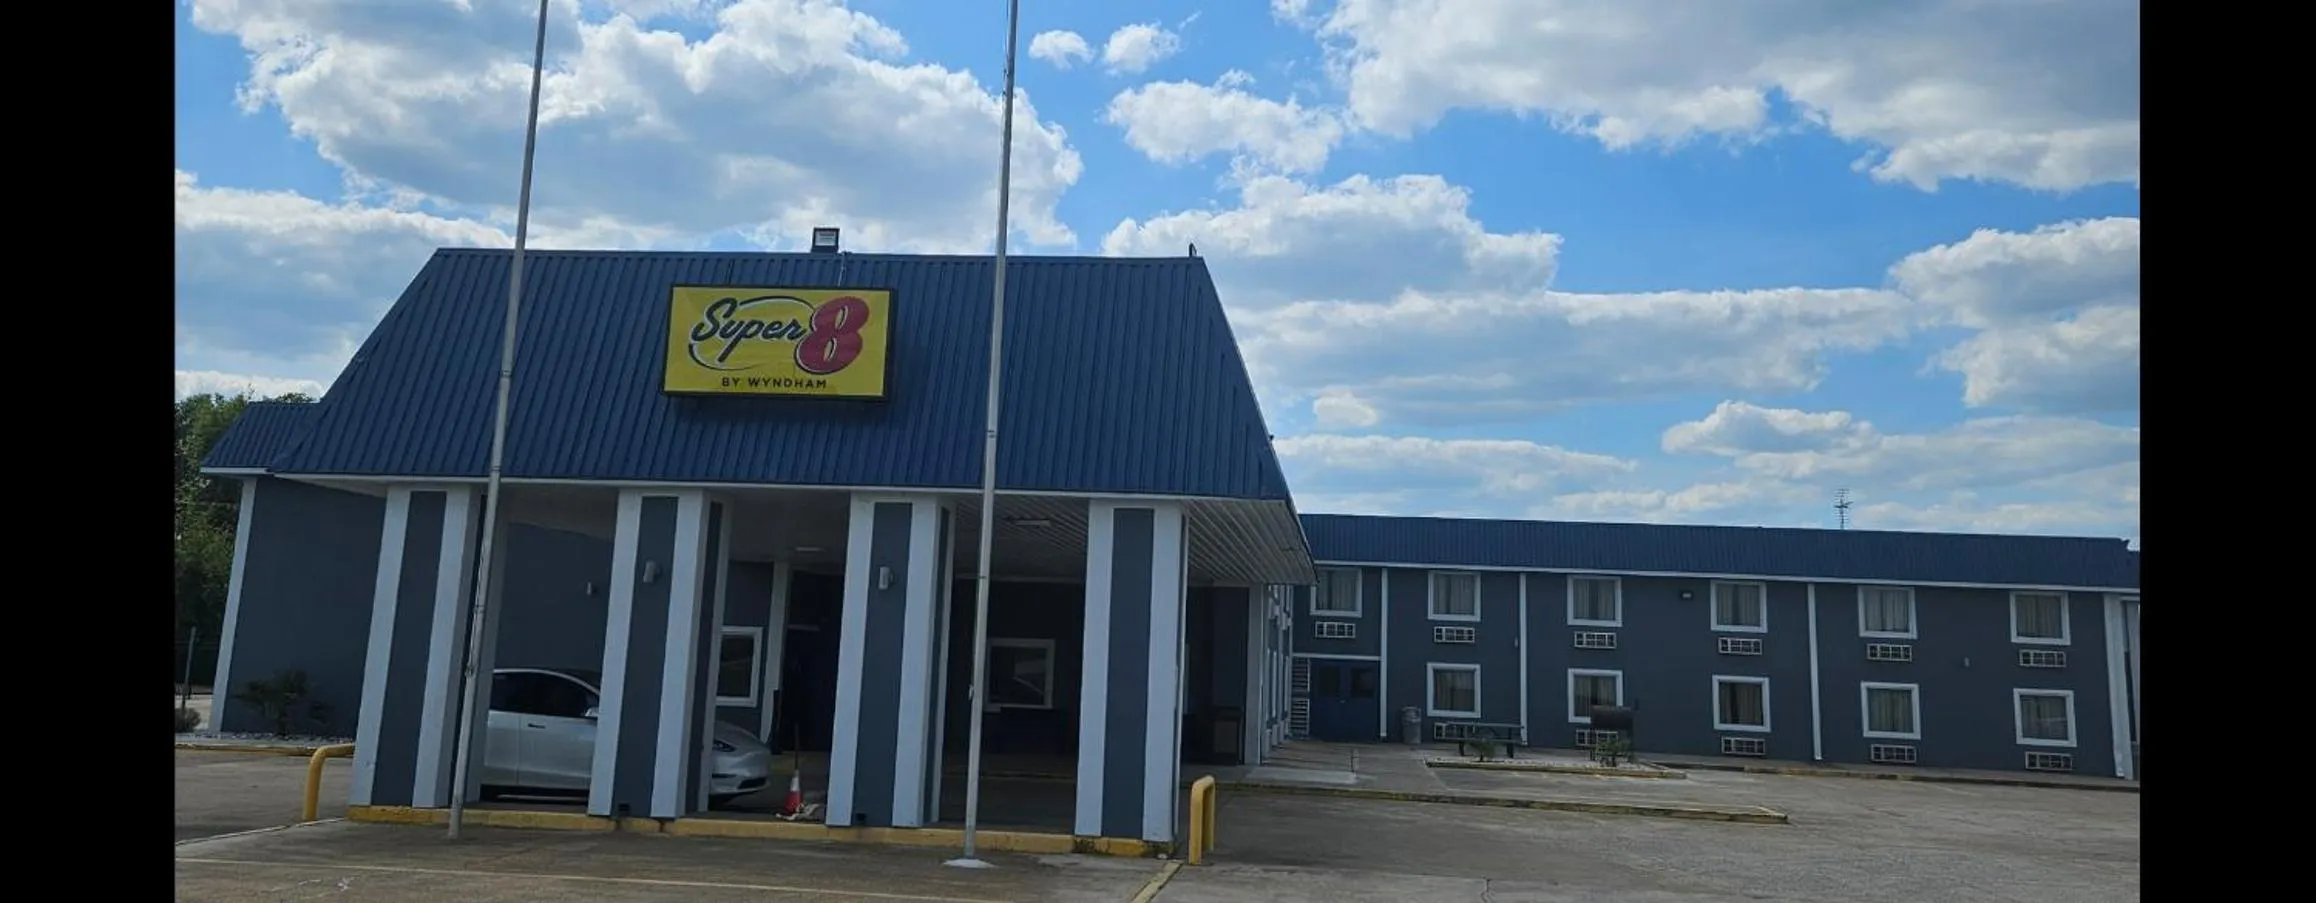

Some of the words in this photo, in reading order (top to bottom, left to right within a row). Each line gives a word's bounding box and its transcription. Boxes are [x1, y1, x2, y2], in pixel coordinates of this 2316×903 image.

[691, 297, 806, 363] Super
[794, 296, 870, 375] 8
[721, 377, 741, 387] BY
[748, 377, 827, 389] WYNDHAM
